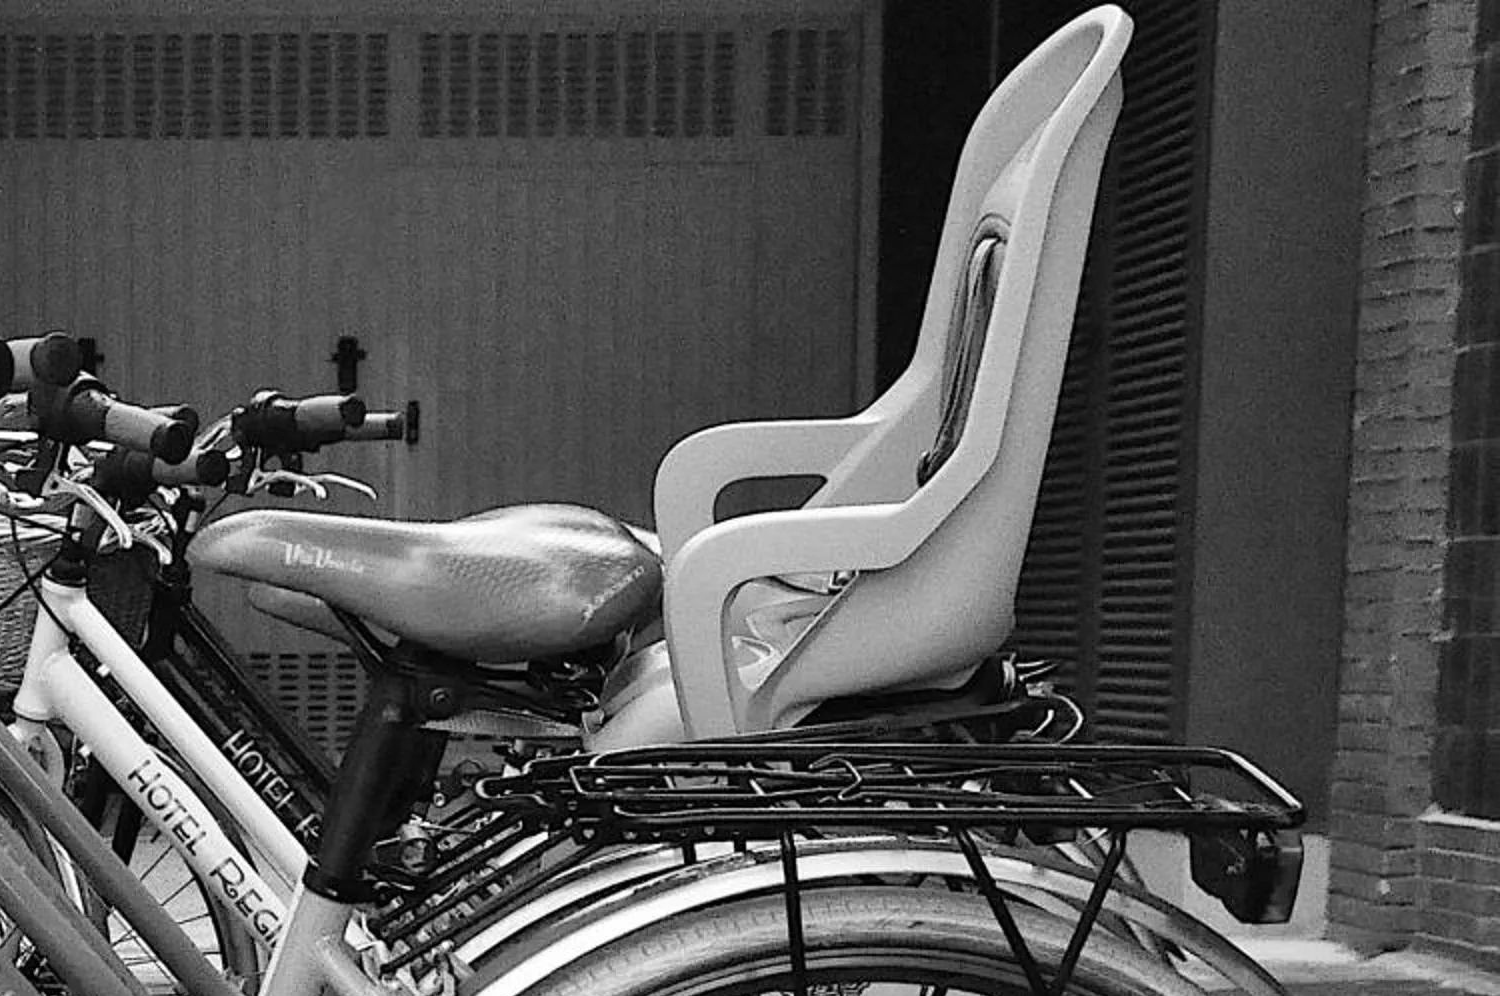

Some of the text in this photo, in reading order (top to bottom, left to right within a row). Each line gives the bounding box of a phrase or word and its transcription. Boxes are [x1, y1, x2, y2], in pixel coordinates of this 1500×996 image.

[221, 728, 296, 812] HOTEL
[127, 759, 283, 949] HOTEL REGI
